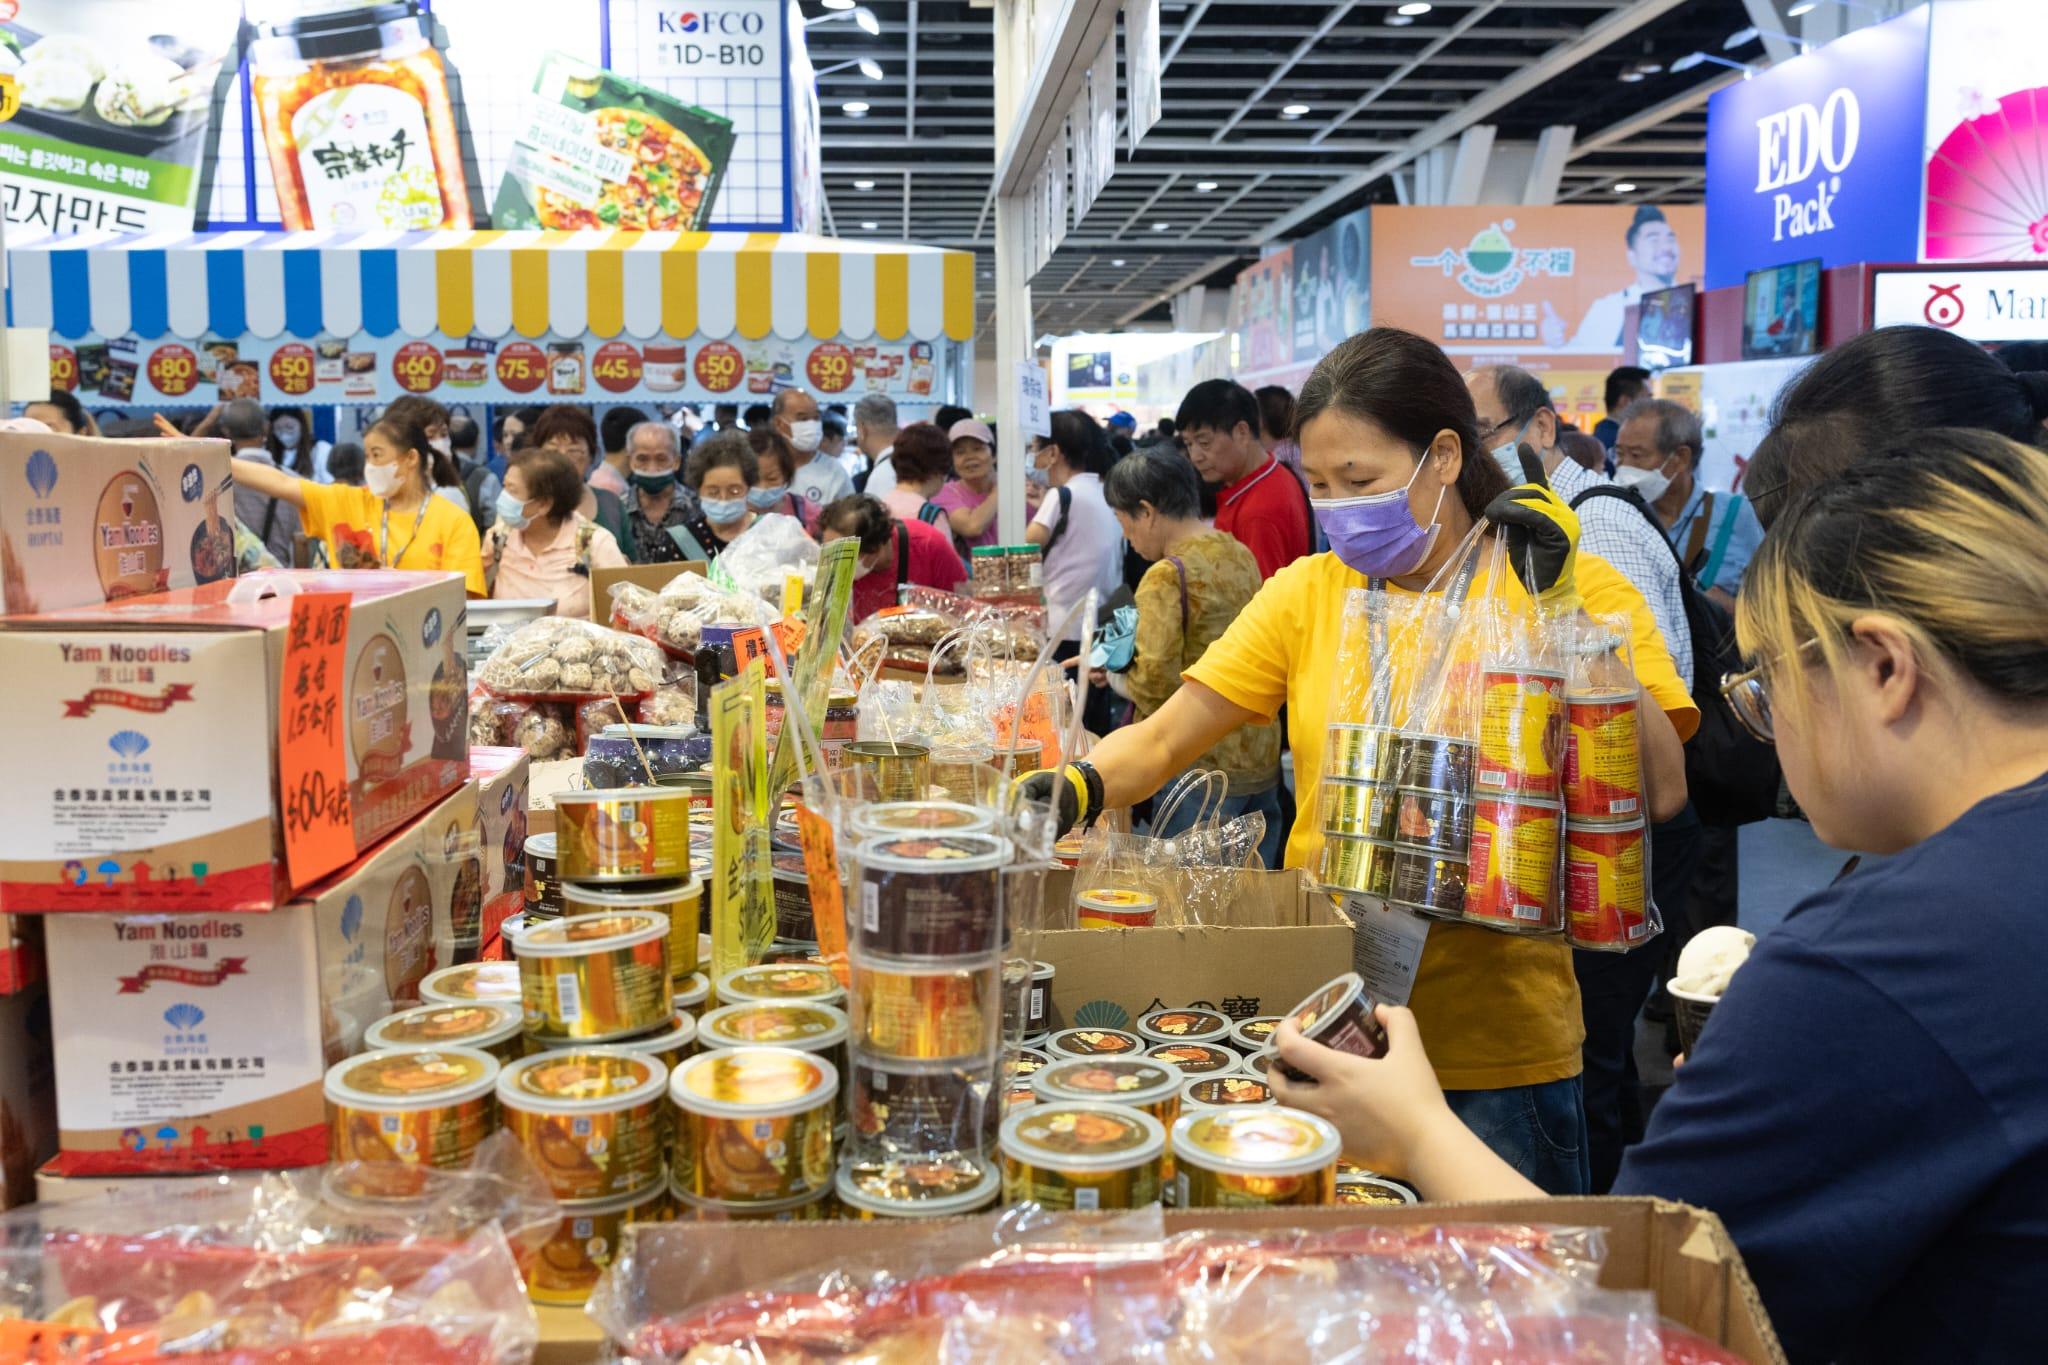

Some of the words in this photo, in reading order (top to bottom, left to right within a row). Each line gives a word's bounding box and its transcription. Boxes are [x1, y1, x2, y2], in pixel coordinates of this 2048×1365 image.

[673, 44, 764, 65] 1D-B10
[1754, 87, 1860, 193] EDO
[1773, 180, 1835, 242] Pack
[152, 357, 191, 378] $80
[272, 356, 309, 377] $50
[398, 355, 436, 376] $60
[499, 359, 530, 378] $75
[594, 359, 629, 378] $45
[700, 355, 735, 376] $50
[812, 355, 848, 376] $30
[60, 644, 102, 663] Yam
[109, 644, 191, 663] Noodles
[114, 922, 155, 940] Yam
[162, 920, 244, 939] Noodles
